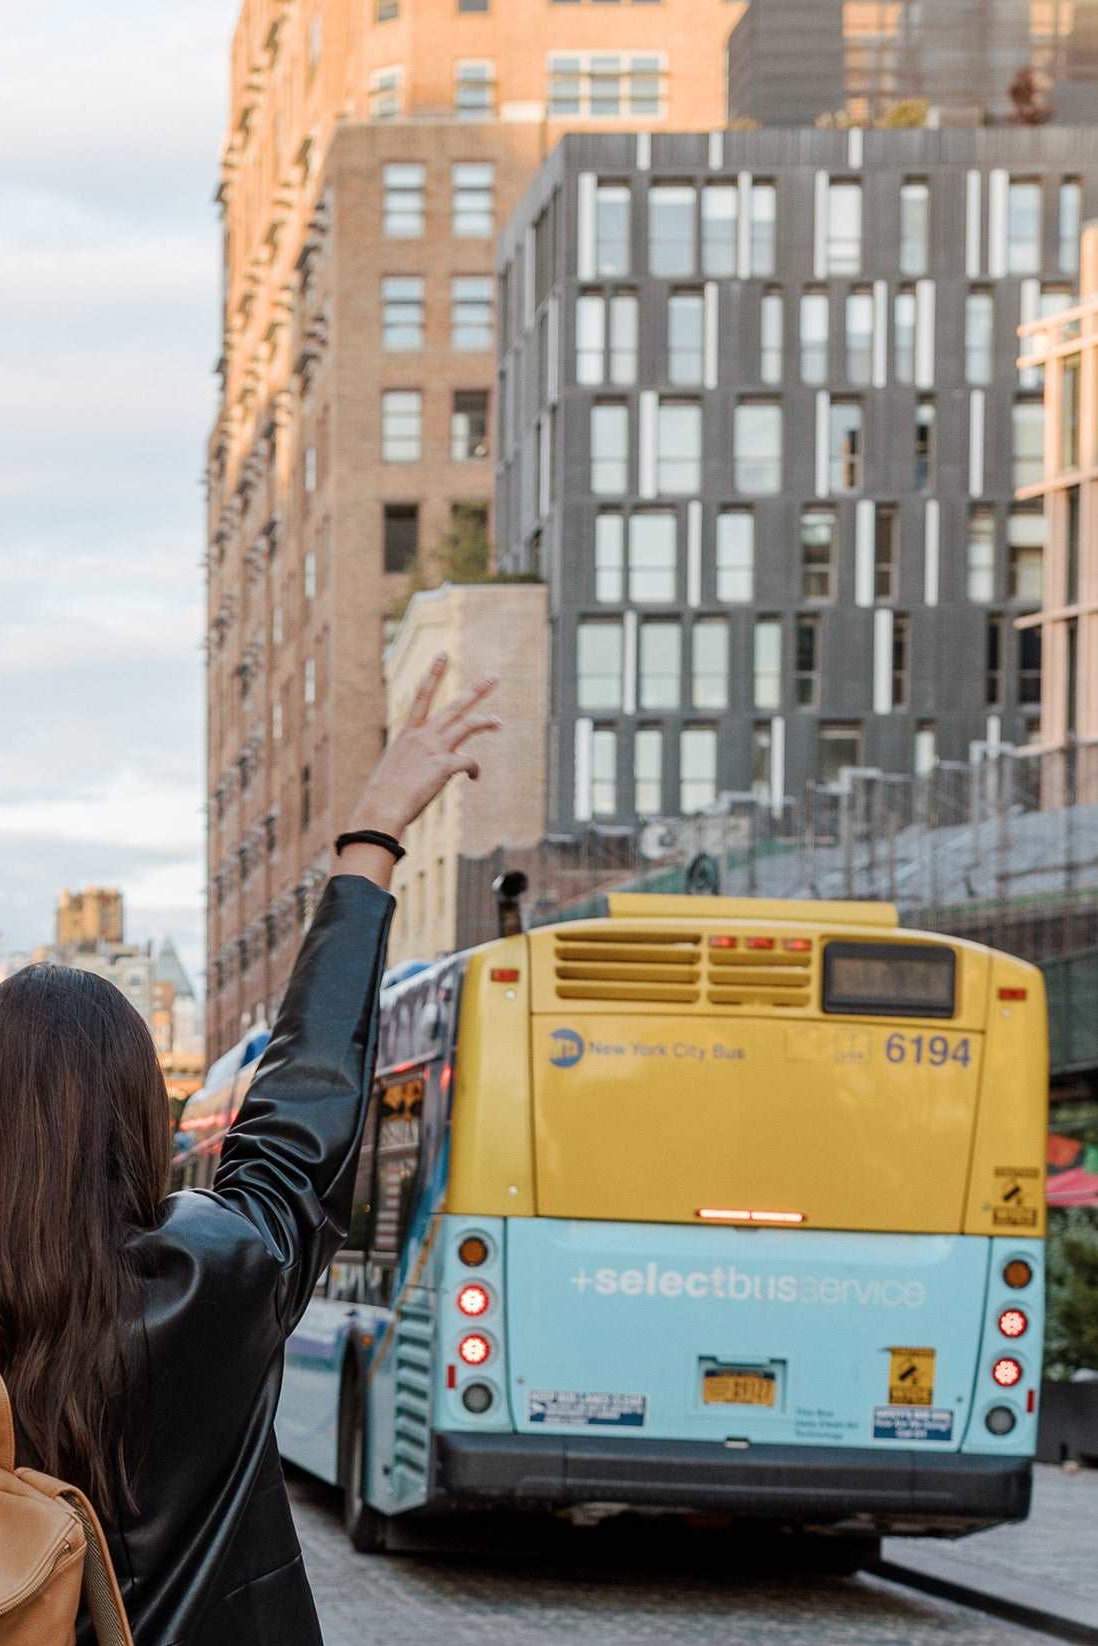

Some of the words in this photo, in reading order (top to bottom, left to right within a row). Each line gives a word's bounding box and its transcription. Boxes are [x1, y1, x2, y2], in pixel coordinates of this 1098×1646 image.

[589, 1041, 626, 1057] New
[631, 1041, 667, 1057] York
[673, 1042, 706, 1062] City
[713, 1043, 746, 1060] Bus
[885, 1032, 971, 1067] 6194
